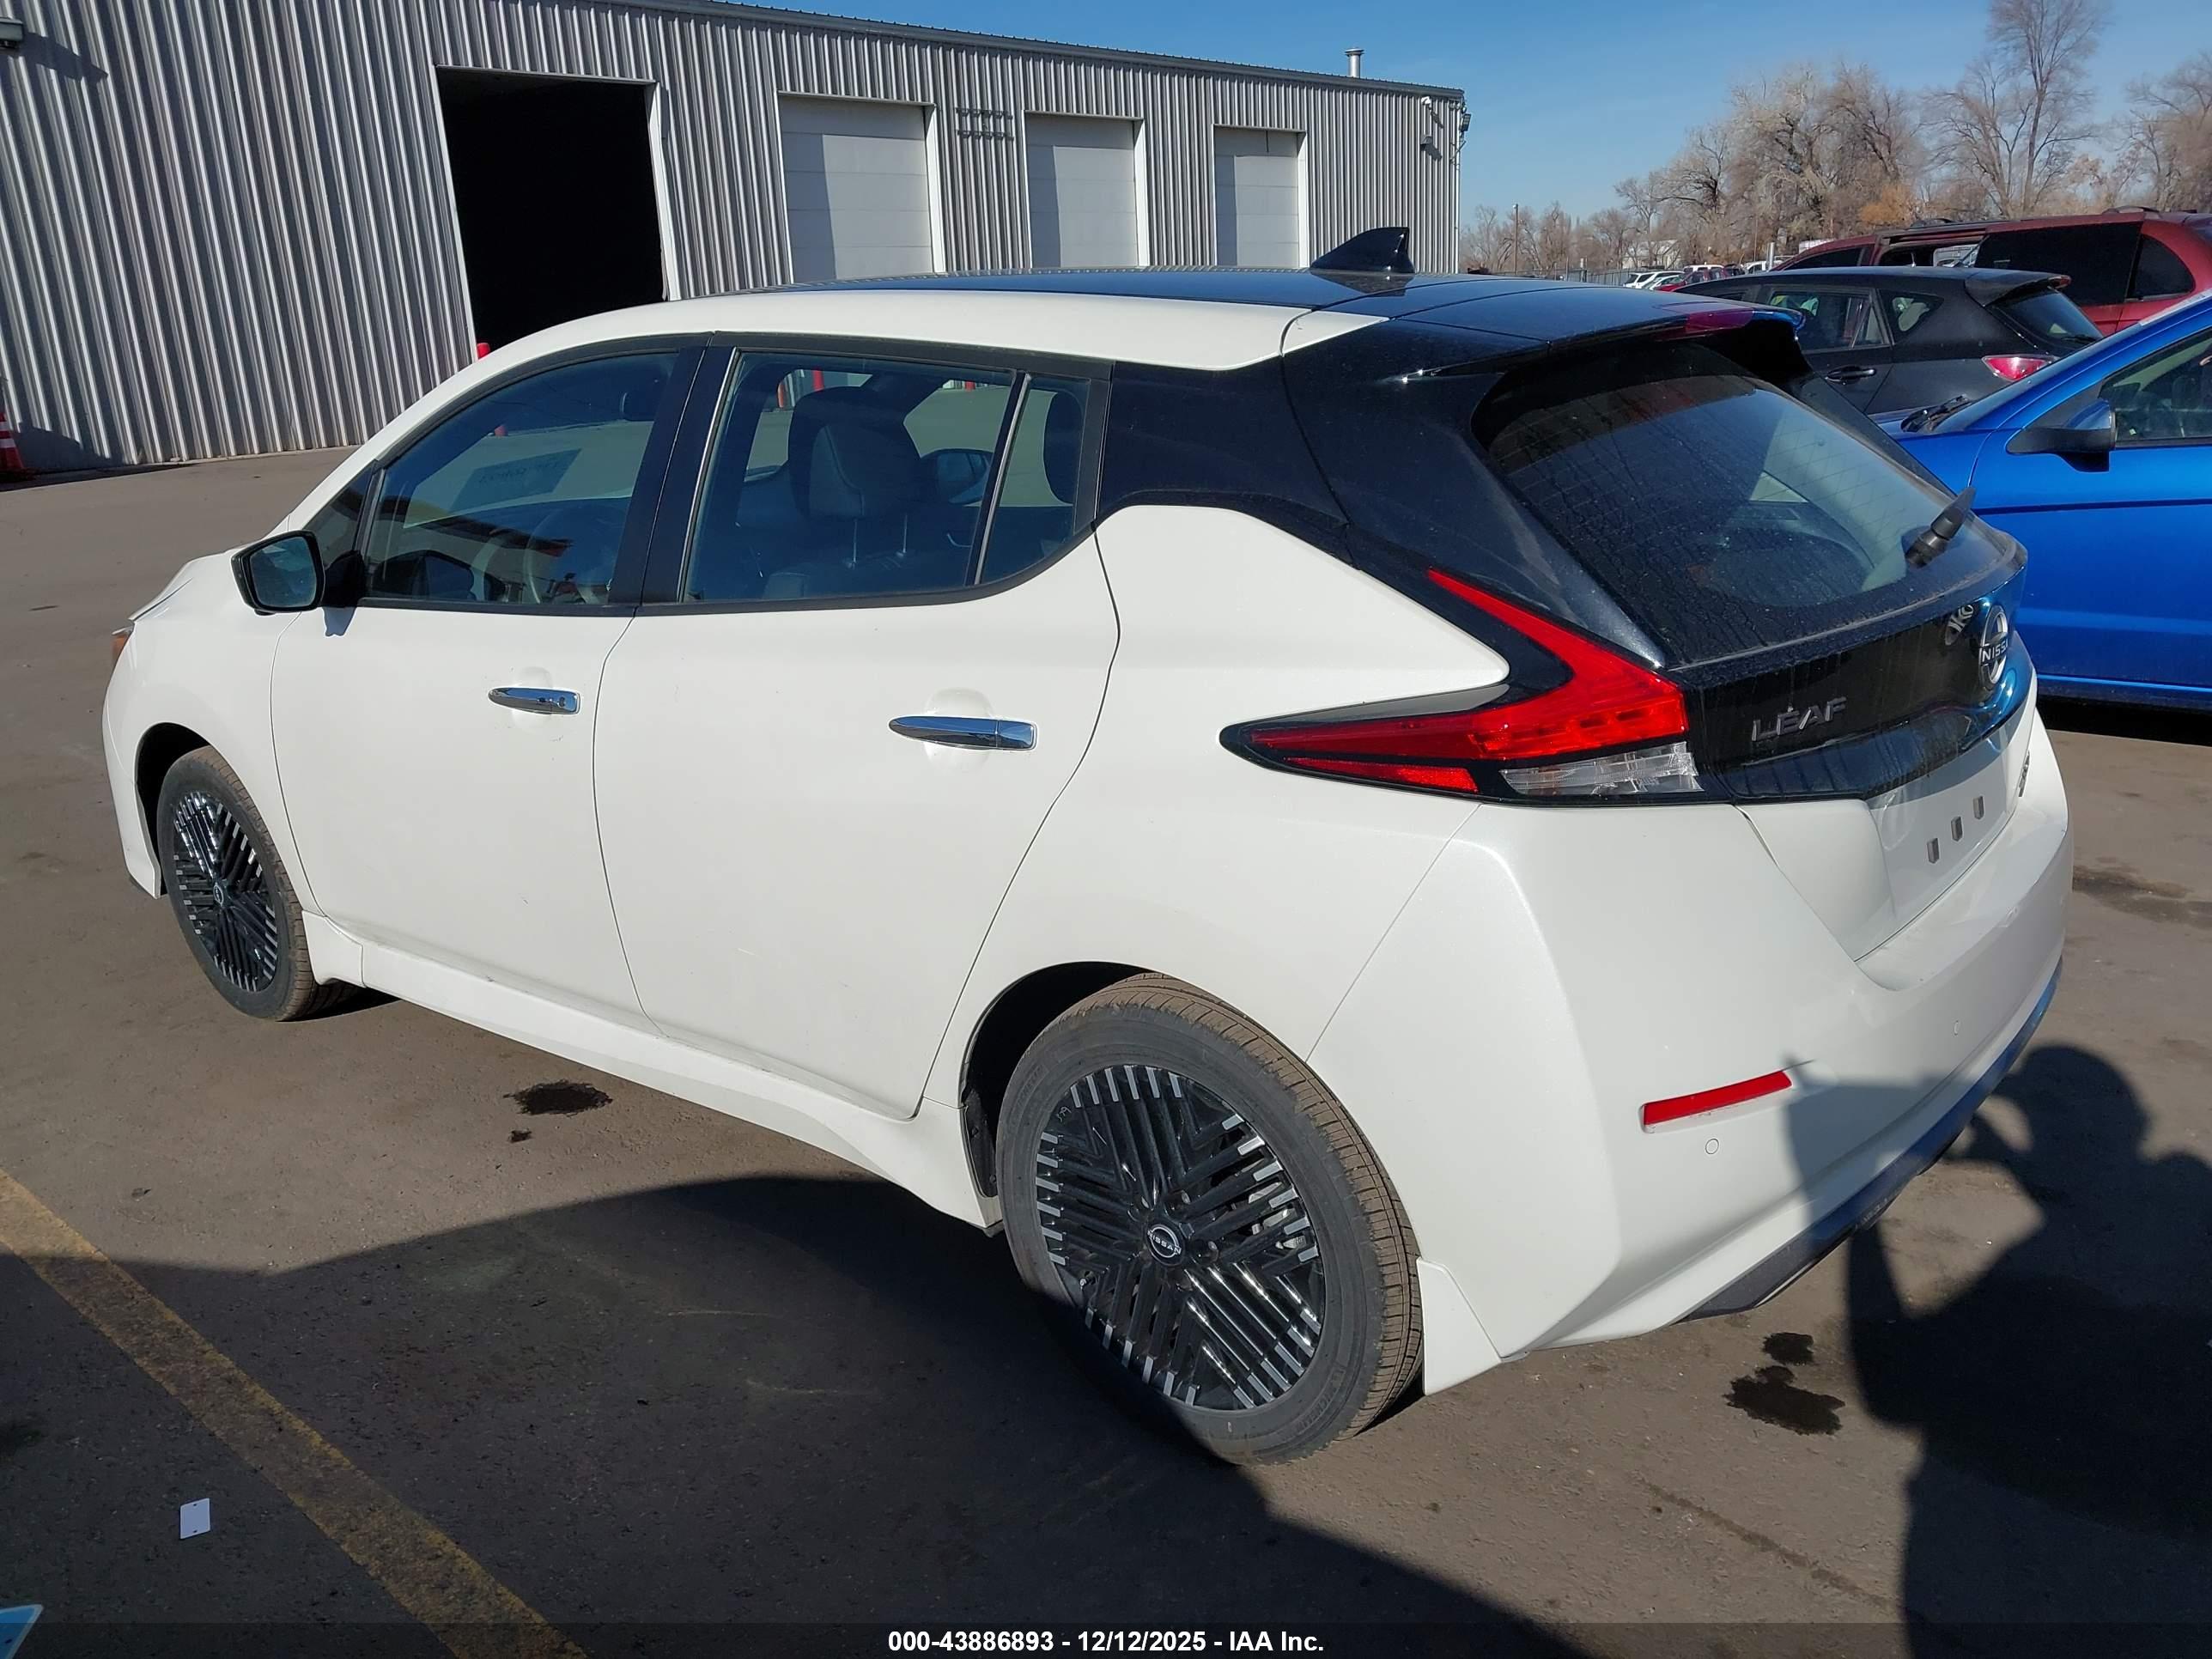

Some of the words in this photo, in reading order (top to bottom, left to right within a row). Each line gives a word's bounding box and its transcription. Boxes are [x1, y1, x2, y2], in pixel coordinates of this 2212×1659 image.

[1982, 640, 2008, 663] NISS
[1752, 696, 1846, 742] LEAF
[1147, 1230, 1182, 1255] NISSAN
